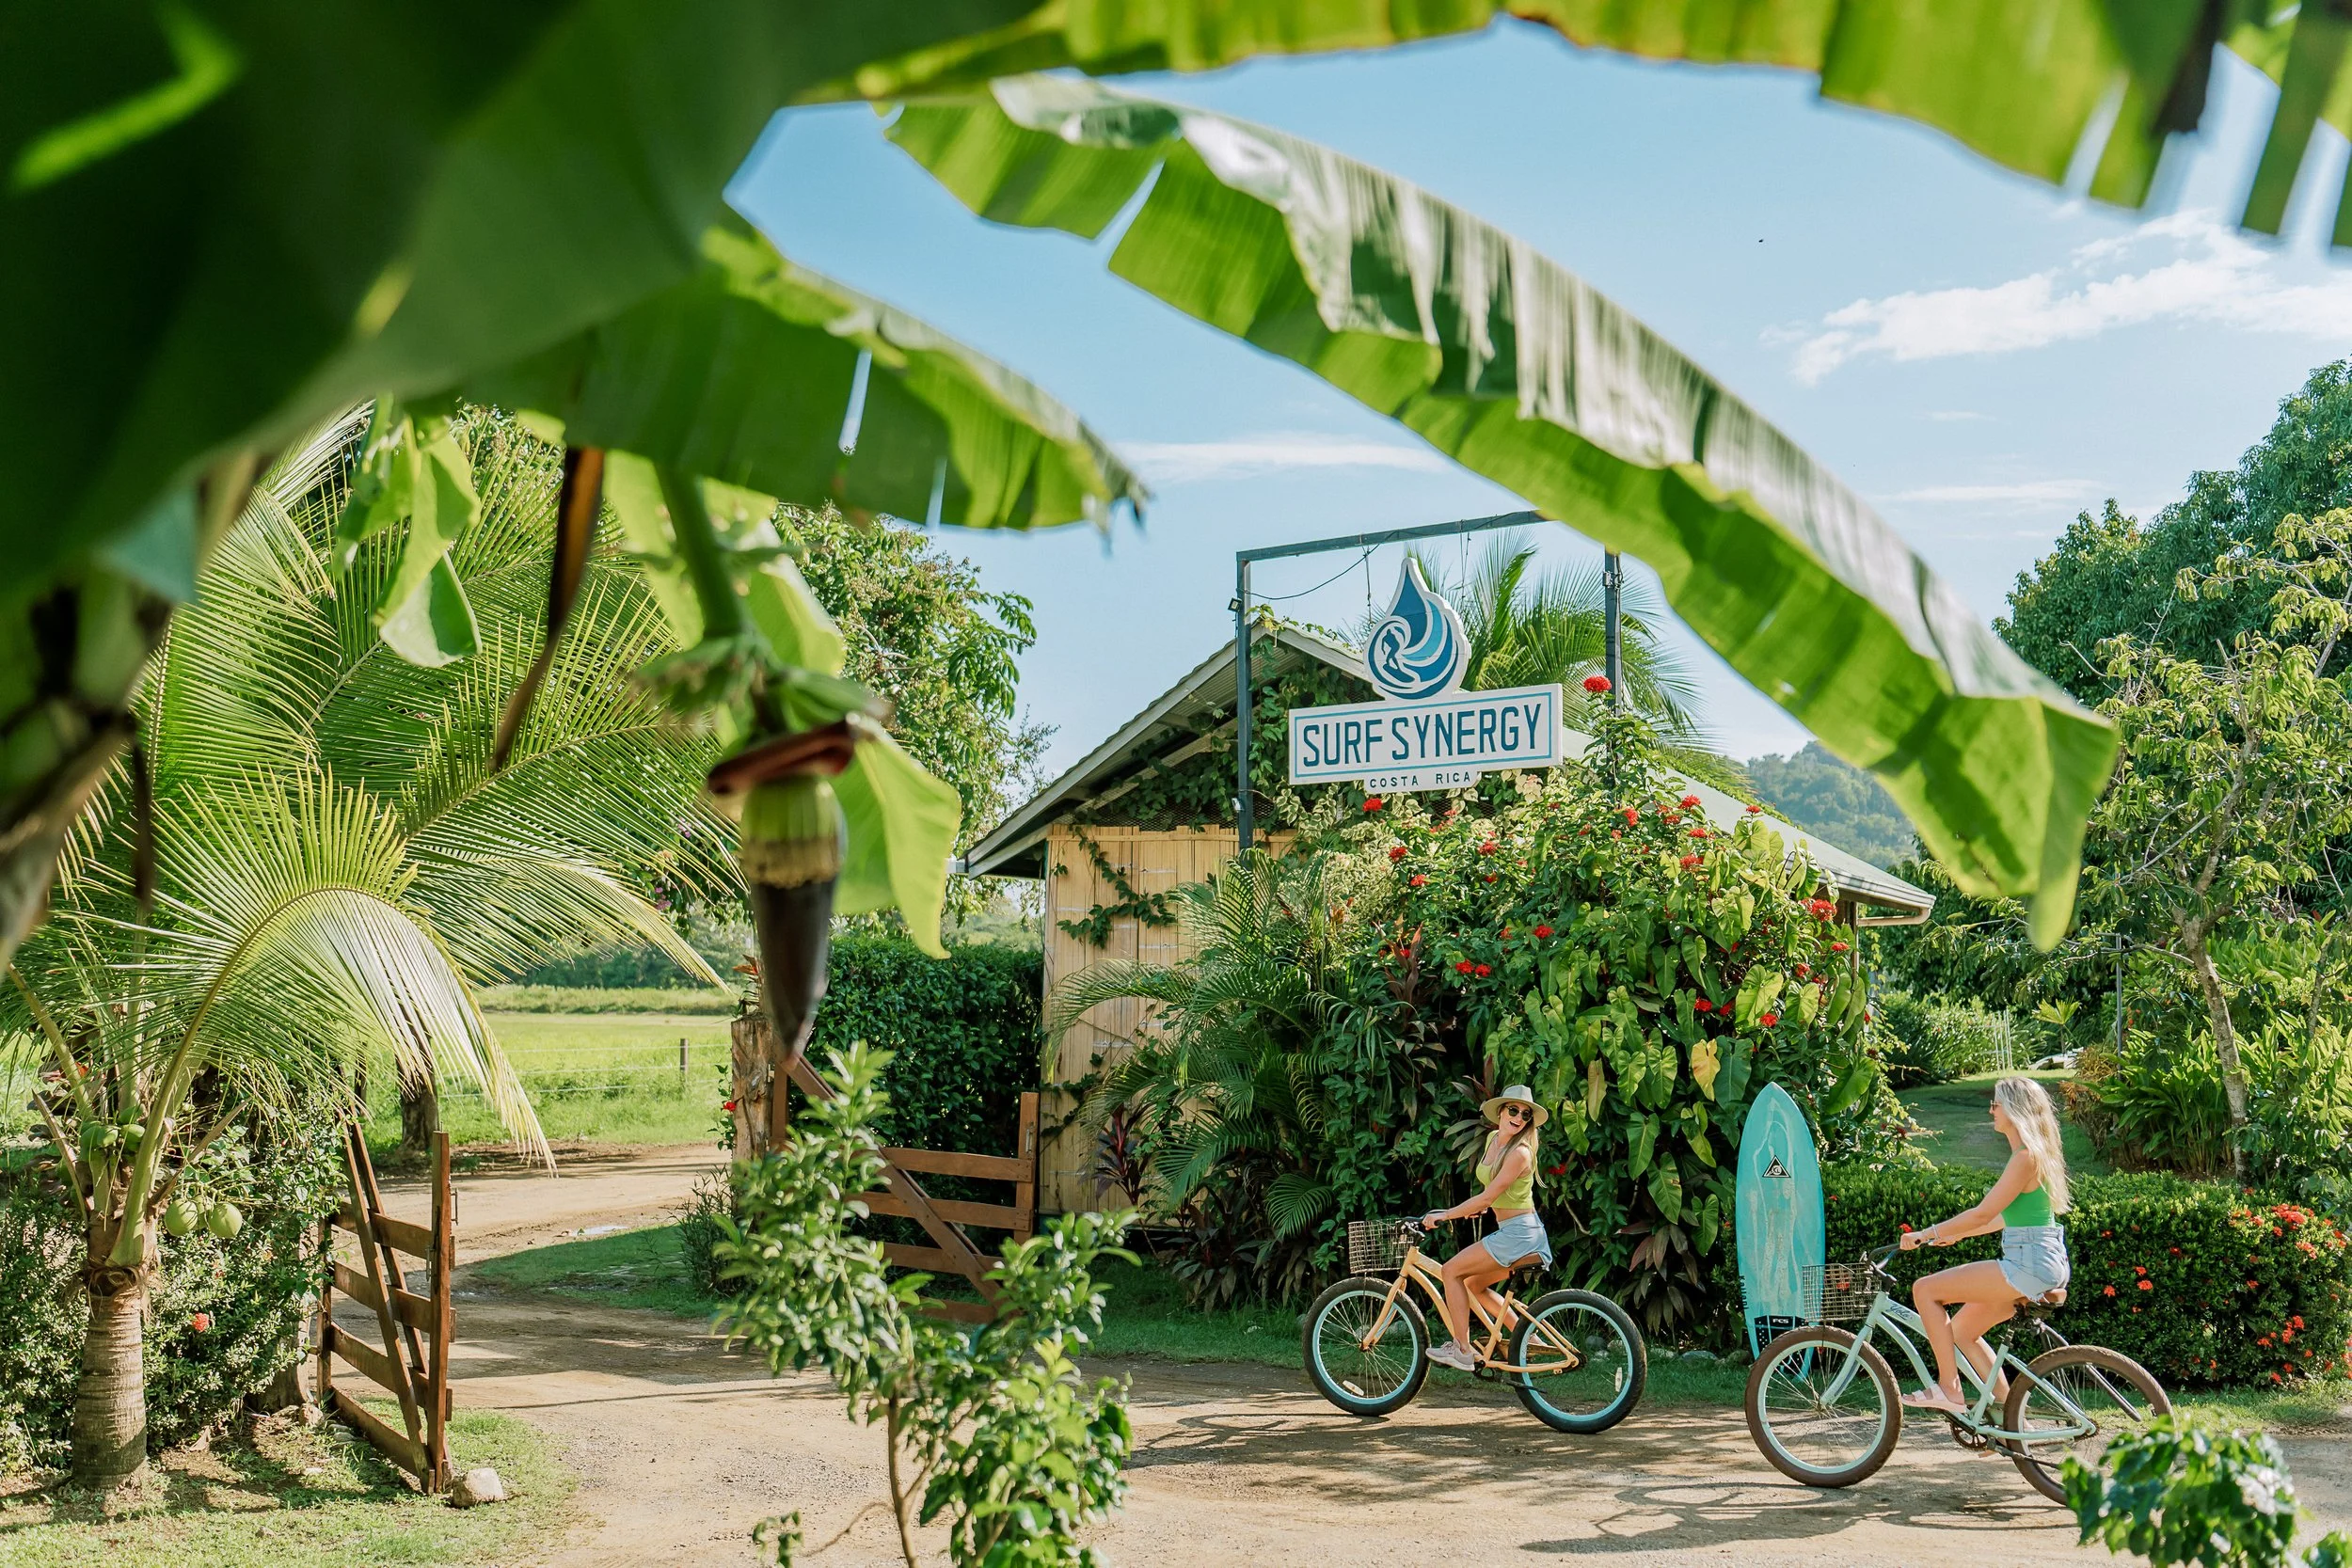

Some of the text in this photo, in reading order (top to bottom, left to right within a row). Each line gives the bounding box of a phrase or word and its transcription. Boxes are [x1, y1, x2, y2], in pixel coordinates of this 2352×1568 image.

[1303, 704, 1541, 768] SURF SYNERGY
[1369, 771, 1470, 788] COSTA RICA
